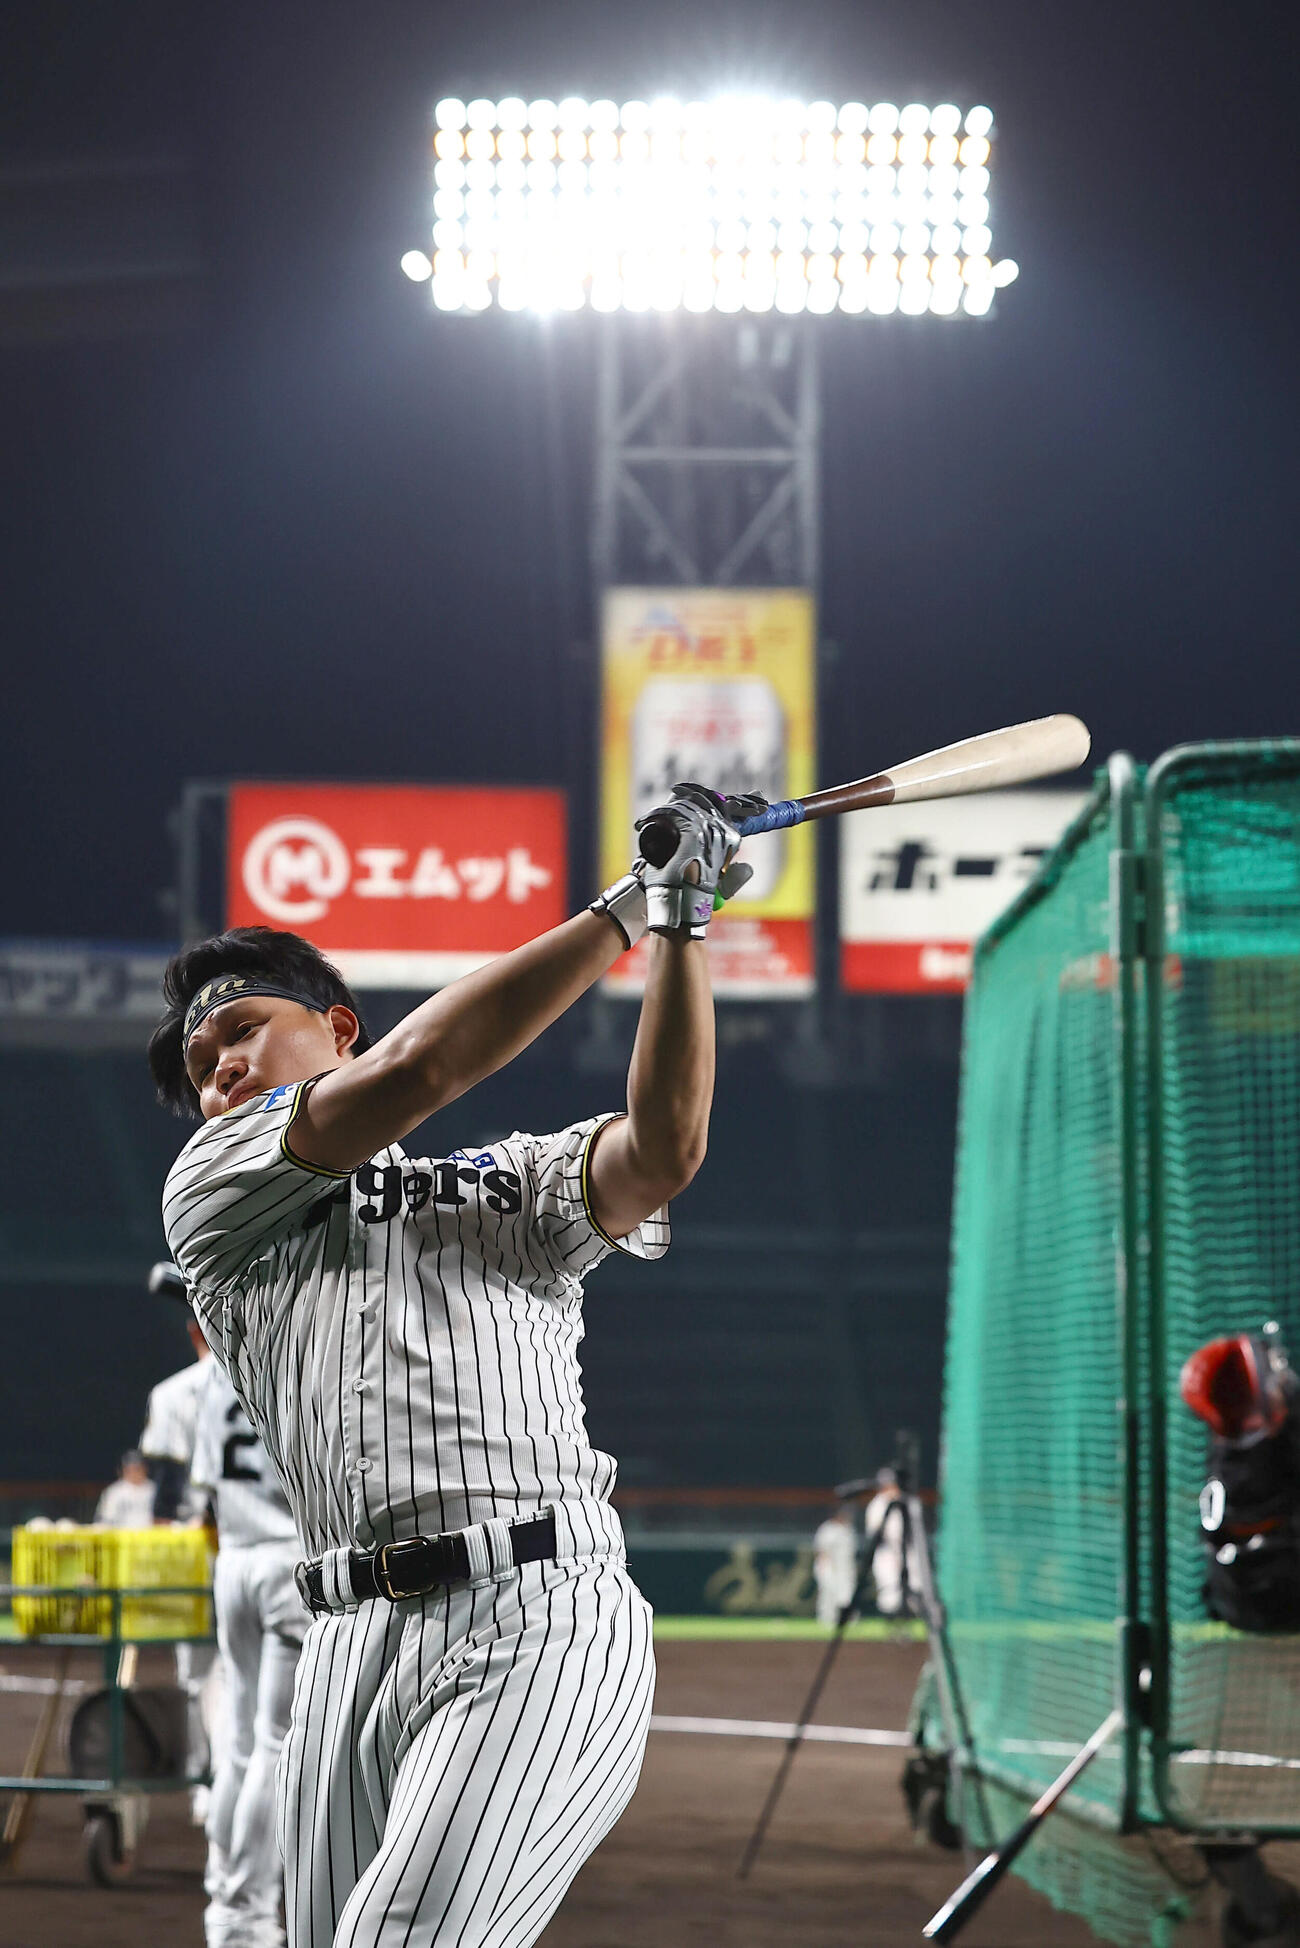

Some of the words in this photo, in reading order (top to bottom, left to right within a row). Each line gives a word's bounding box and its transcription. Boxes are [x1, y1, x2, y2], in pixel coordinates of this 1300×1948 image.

[354, 845, 551, 903] エムット
[302, 1162, 522, 1228] gers
